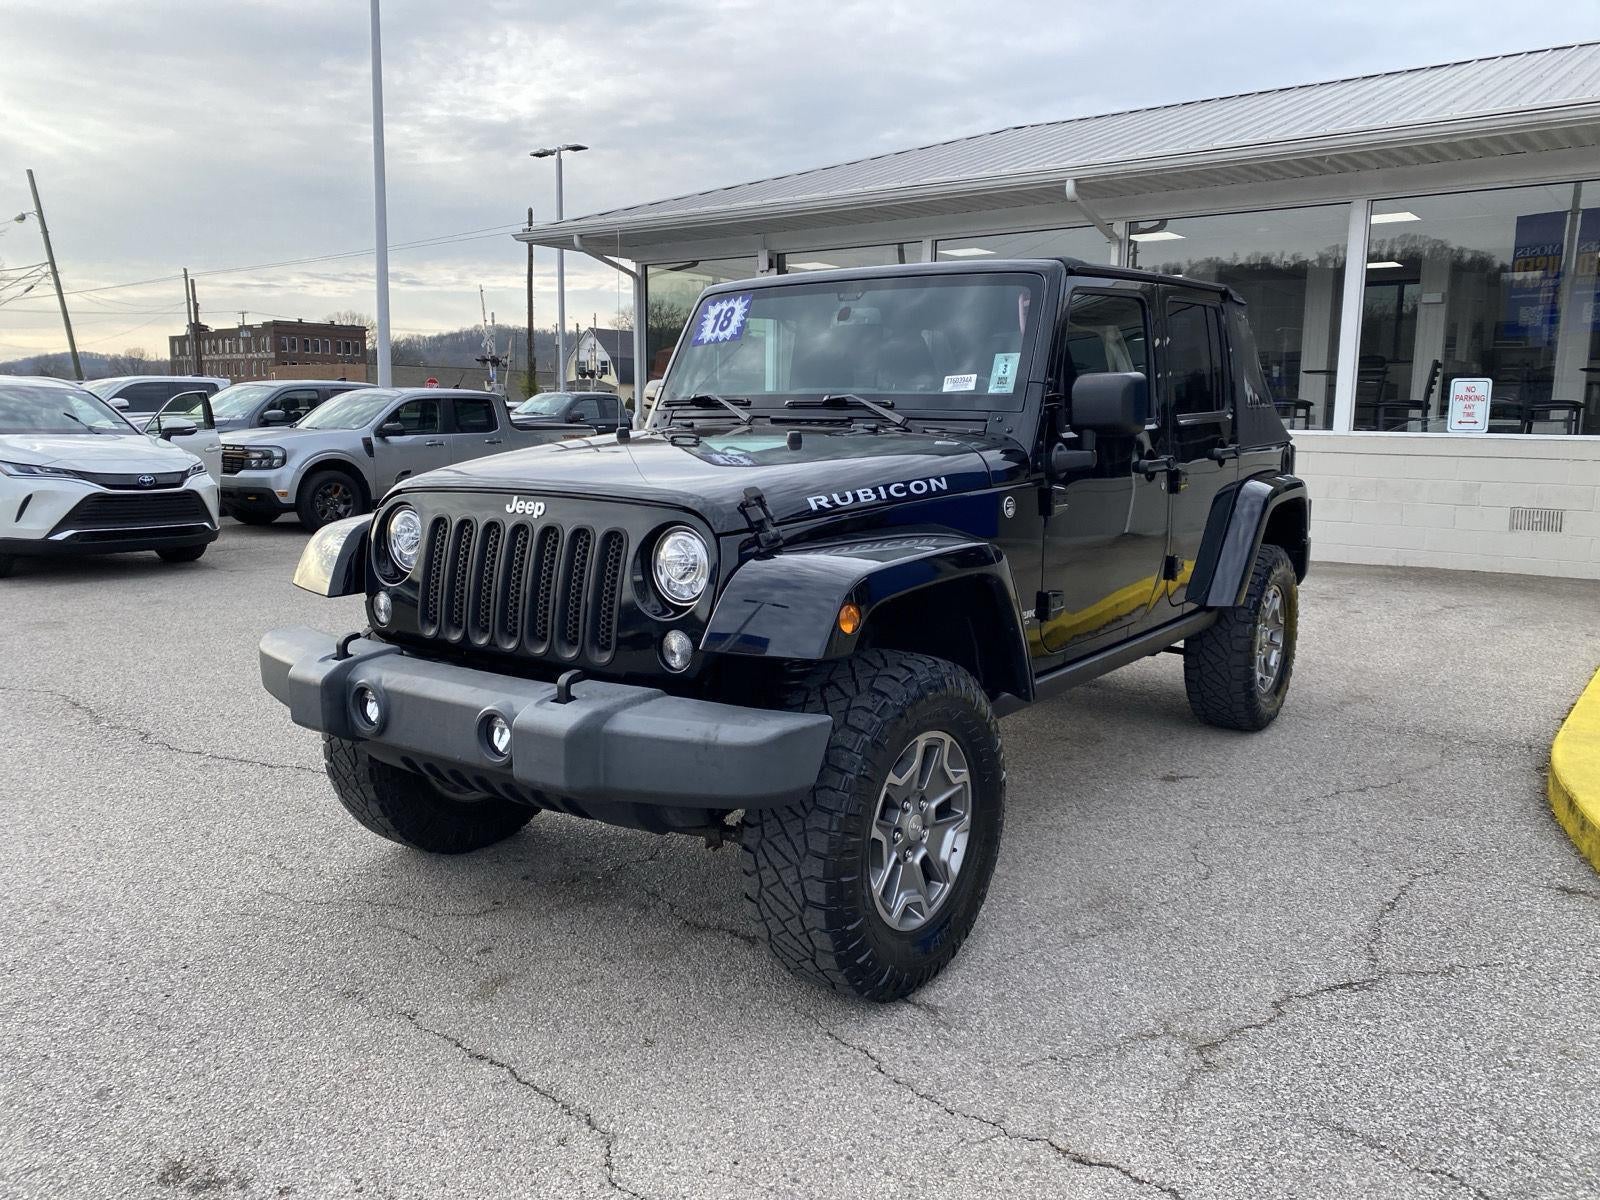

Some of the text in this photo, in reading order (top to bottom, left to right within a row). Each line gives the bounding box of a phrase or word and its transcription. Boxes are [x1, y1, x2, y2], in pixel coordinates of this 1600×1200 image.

[711, 306, 736, 334] 18
[1455, 394, 1486, 402] PARKING
[1465, 385, 1477, 393] NO
[806, 476, 948, 511] RUBICON
[505, 495, 546, 519] Jeep
